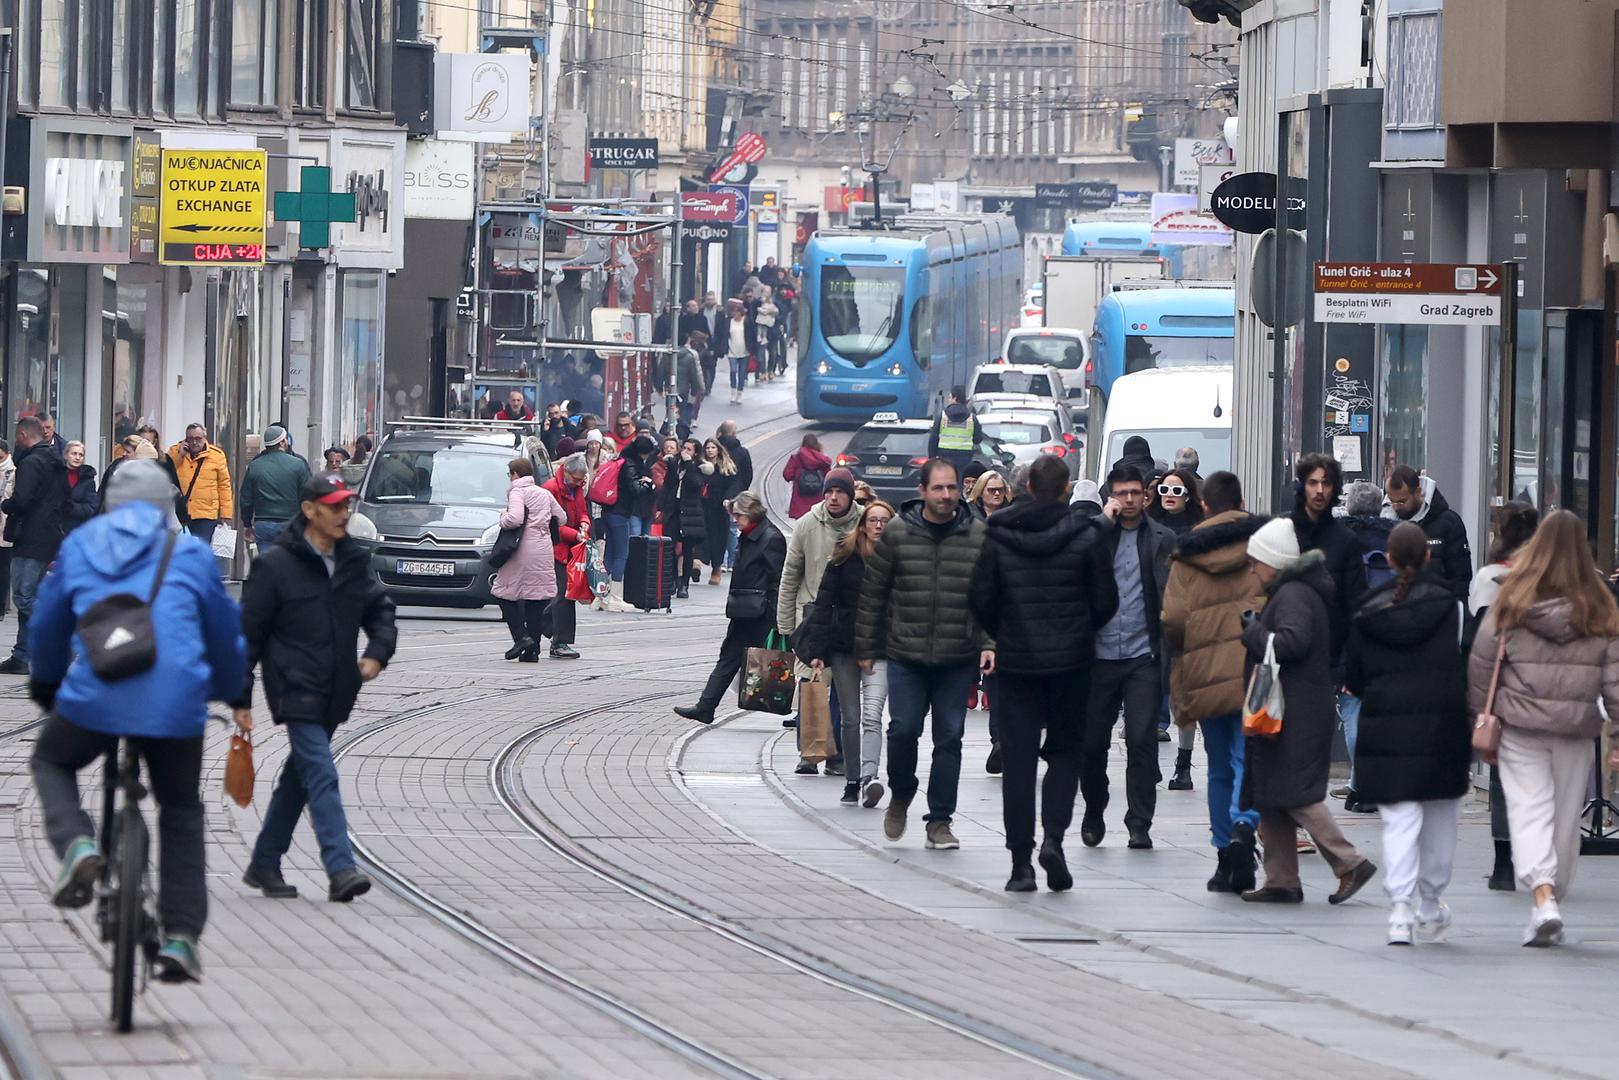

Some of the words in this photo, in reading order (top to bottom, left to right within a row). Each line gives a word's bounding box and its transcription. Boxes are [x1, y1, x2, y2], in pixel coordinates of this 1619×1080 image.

[589, 147, 655, 160] STRUGAR
[169, 179, 217, 192] OTKUP
[220, 180, 261, 192] ZLATA
[404, 171, 470, 189] BLISS
[176, 199, 253, 212] EXCHANGE
[194, 244, 233, 260] CIJA
[1318, 266, 1347, 277] Tunel
[1349, 266, 1372, 277] Grič
[1380, 267, 1402, 278] ulaz
[1404, 267, 1411, 278] 4
[1319, 279, 1349, 288] Tunnel
[1350, 280, 1369, 288] Grič
[1375, 281, 1414, 289] entrance
[1415, 281, 1422, 289] 4
[1326, 298, 1369, 308] Besplatni
[1371, 298, 1392, 308] WiFi
[1326, 310, 1346, 319] Free
[1348, 310, 1367, 319] WiFi
[1420, 304, 1449, 316] Grad
[1452, 305, 1494, 318] Zagreb
[403, 562, 415, 573] ZG
[419, 563, 453, 574] 6445-FE
